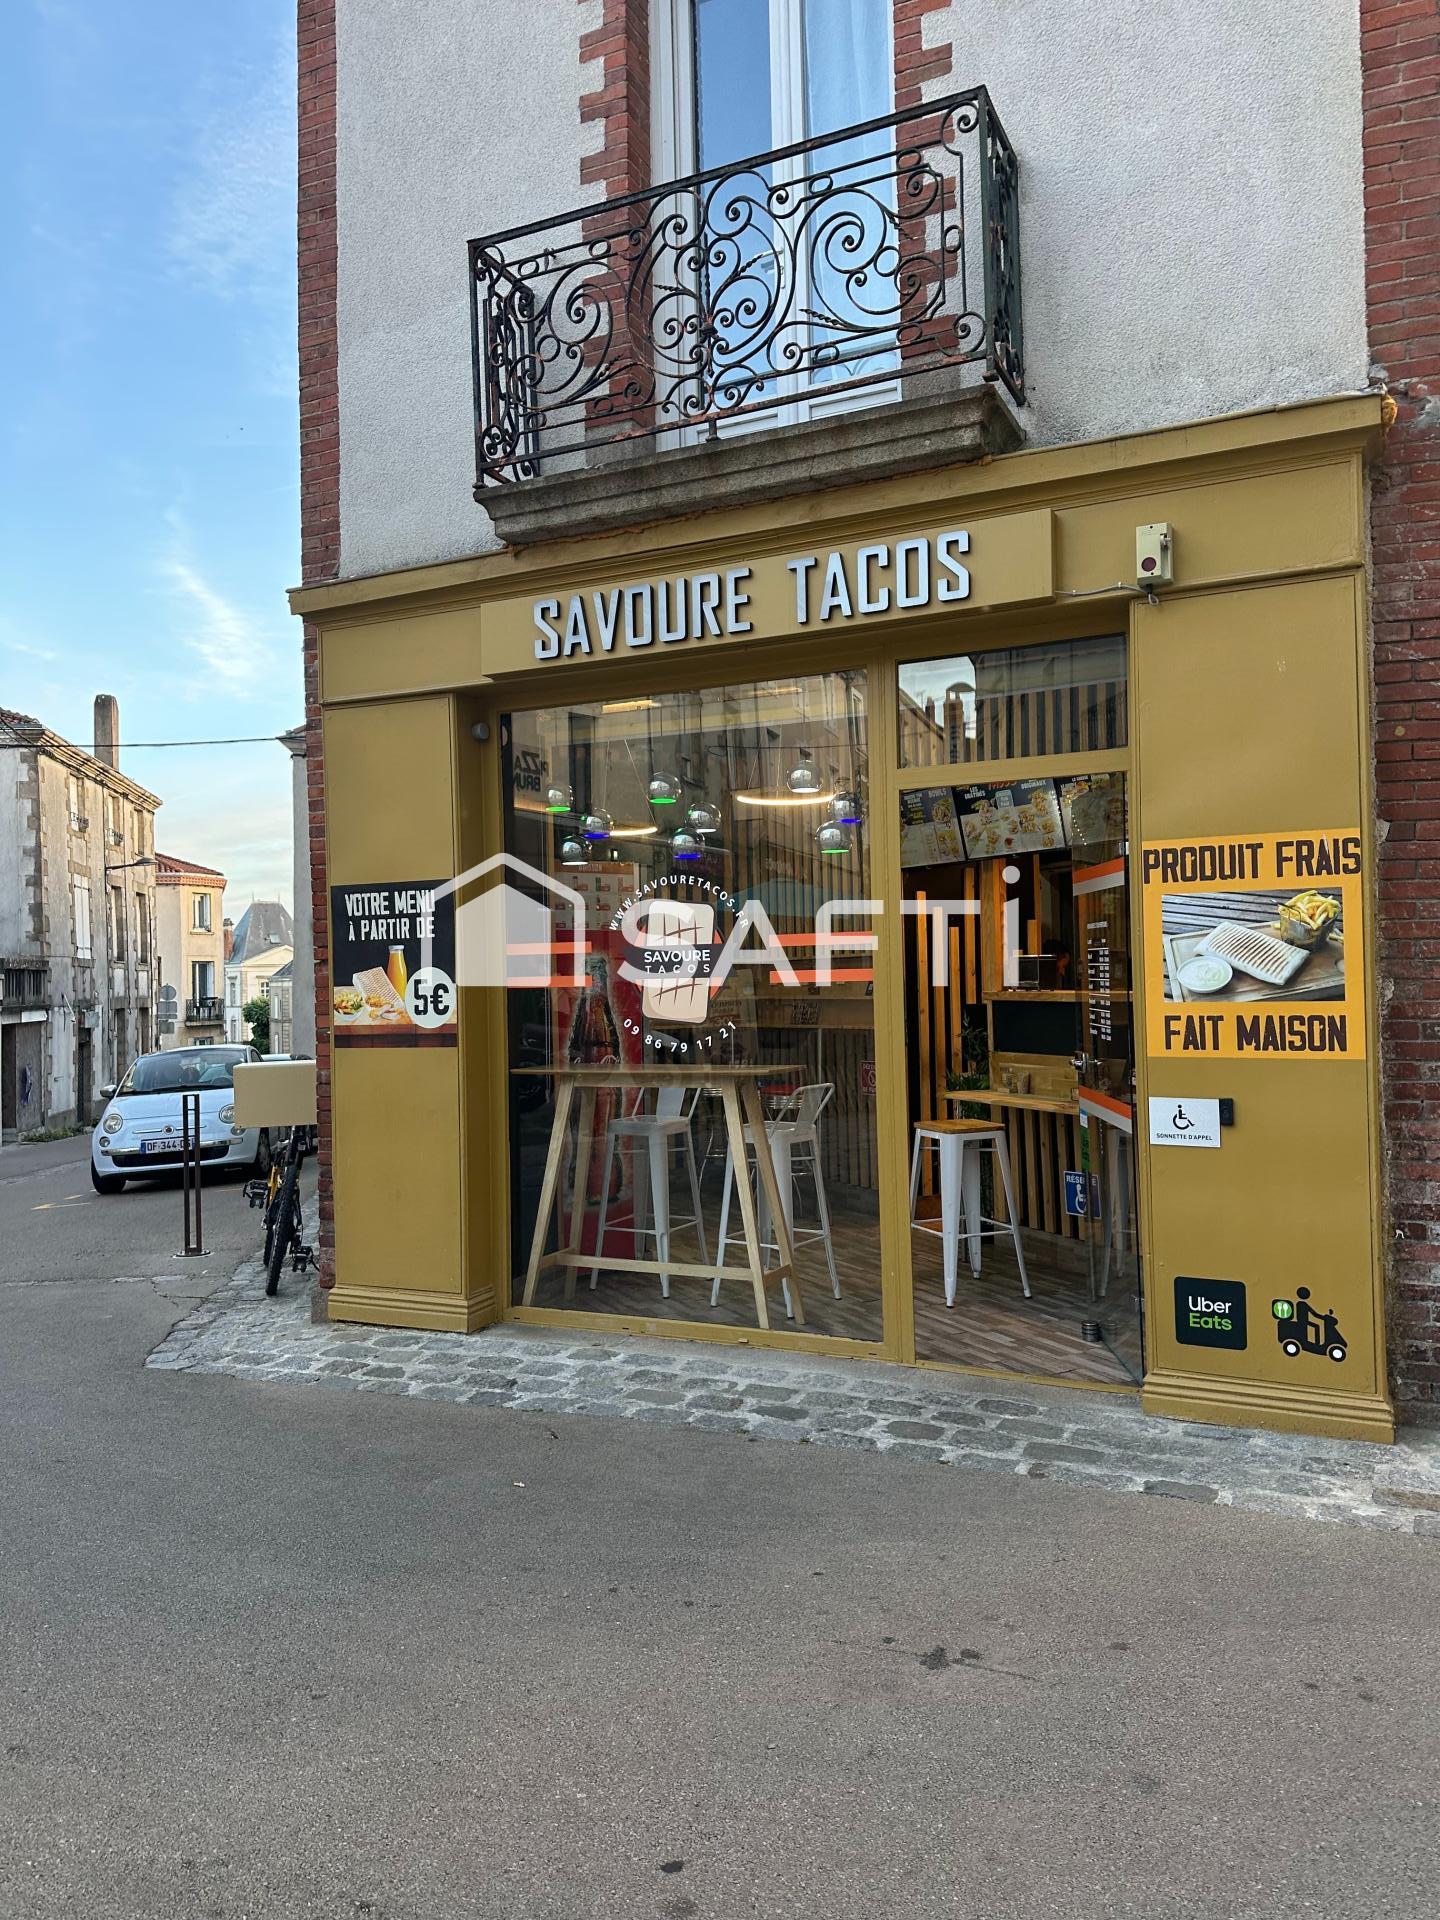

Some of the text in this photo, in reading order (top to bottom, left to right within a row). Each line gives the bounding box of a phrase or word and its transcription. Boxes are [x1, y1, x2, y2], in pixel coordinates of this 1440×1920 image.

[532, 530, 972, 660] SAVOURE TACOS
[1143, 836, 1362, 884] PRODUIT FRAIS
[345, 889, 436, 916] VOTRE MENU
[609, 874, 749, 931] WWW.SAVOURETACOS.FR
[348, 916, 435, 941] À PARTIR DE
[644, 949, 711, 963] SAVOURE
[413, 978, 450, 1016] 5€
[623, 1018, 736, 1053] 09 86 79 17 21
[1163, 1014, 1348, 1052] FAIT MAISON
[1156, 1132, 1187, 1140] SONNETTE
[1188, 1295, 1232, 1314] Uber
[1189, 1313, 1233, 1331] Eats
